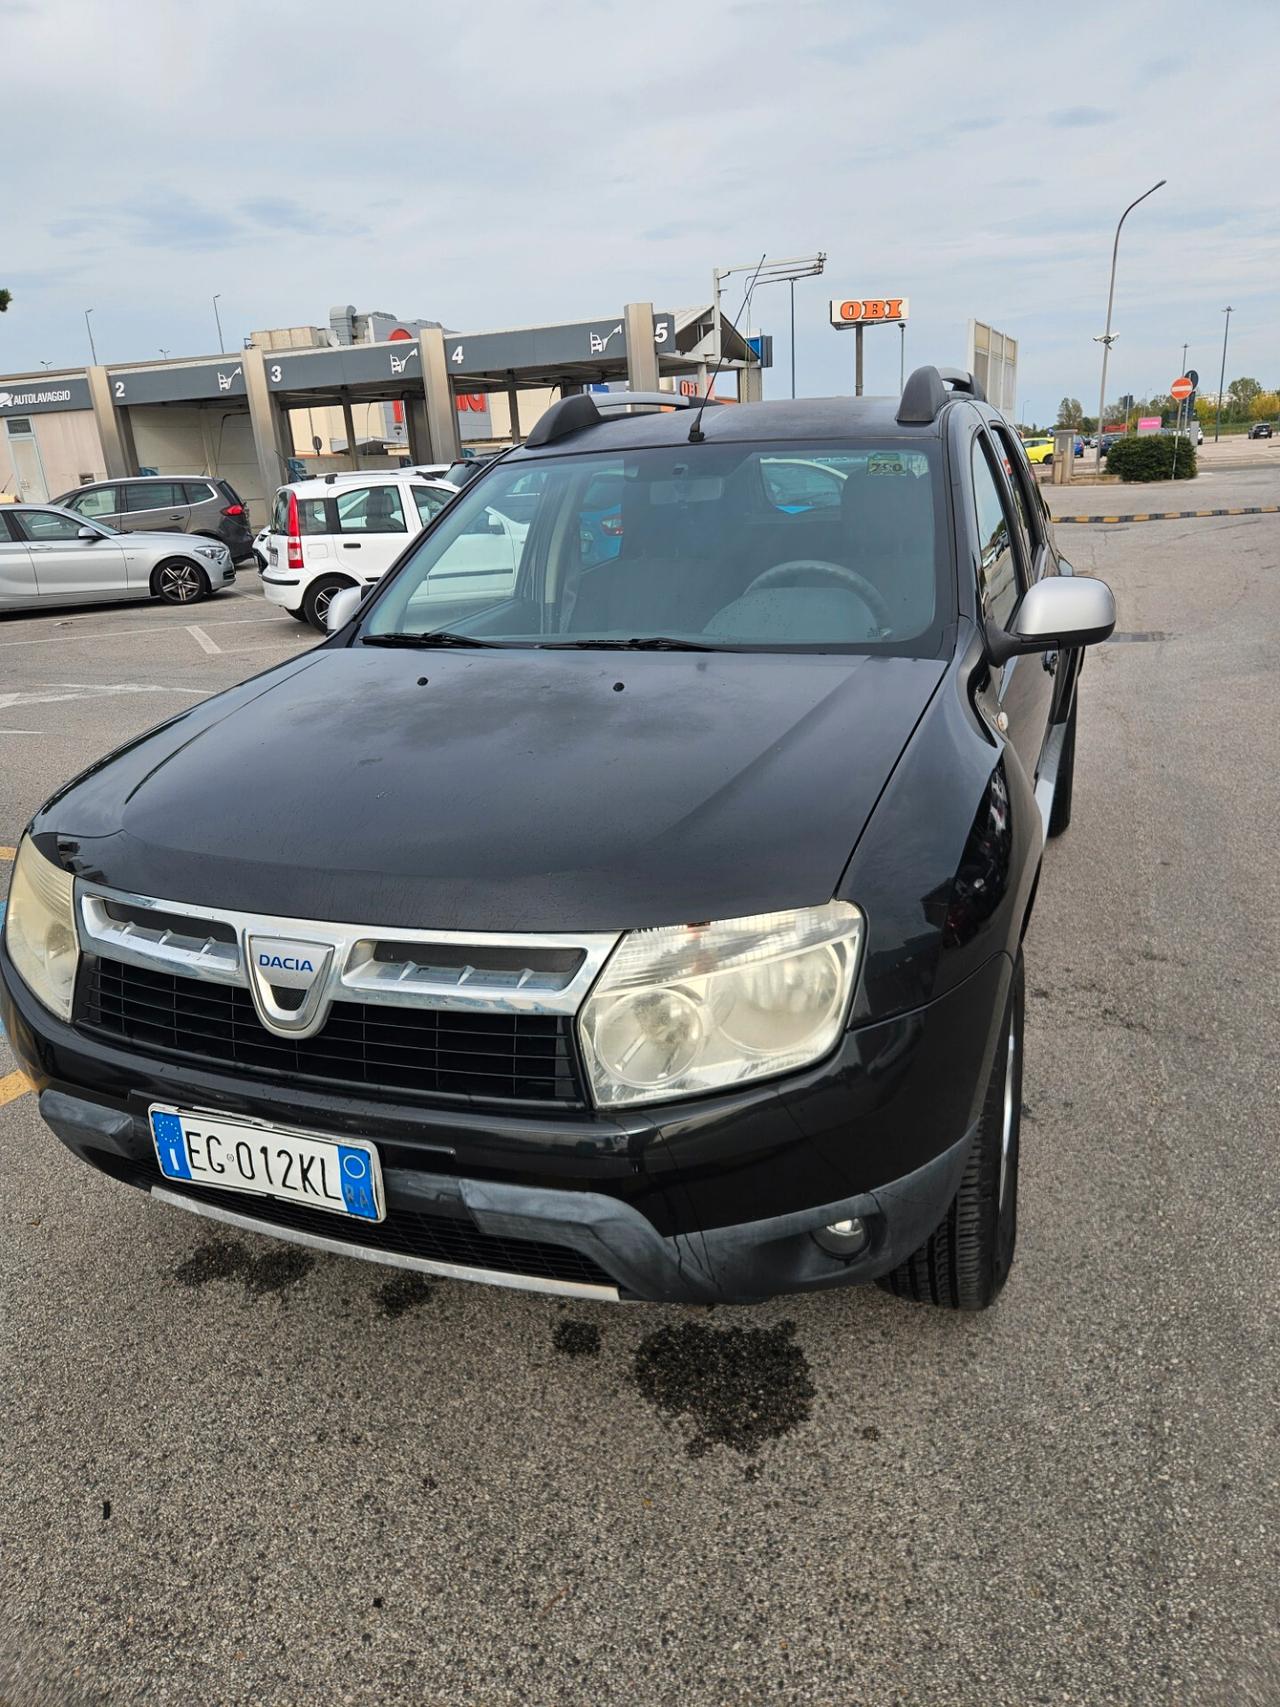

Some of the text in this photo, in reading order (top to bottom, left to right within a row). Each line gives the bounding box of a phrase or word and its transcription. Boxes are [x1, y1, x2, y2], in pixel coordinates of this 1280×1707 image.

[840, 300, 903, 320] OBI
[654, 322, 668, 343] 5
[451, 345, 464, 364] 4
[271, 365, 282, 383] 3
[13, 390, 71, 406] AUTOLAVAGGIO
[115, 381, 126, 398] 2
[259, 954, 314, 973] DACIA
[169, 1148, 180, 1171] I
[185, 1131, 342, 1200] EG 012KL
